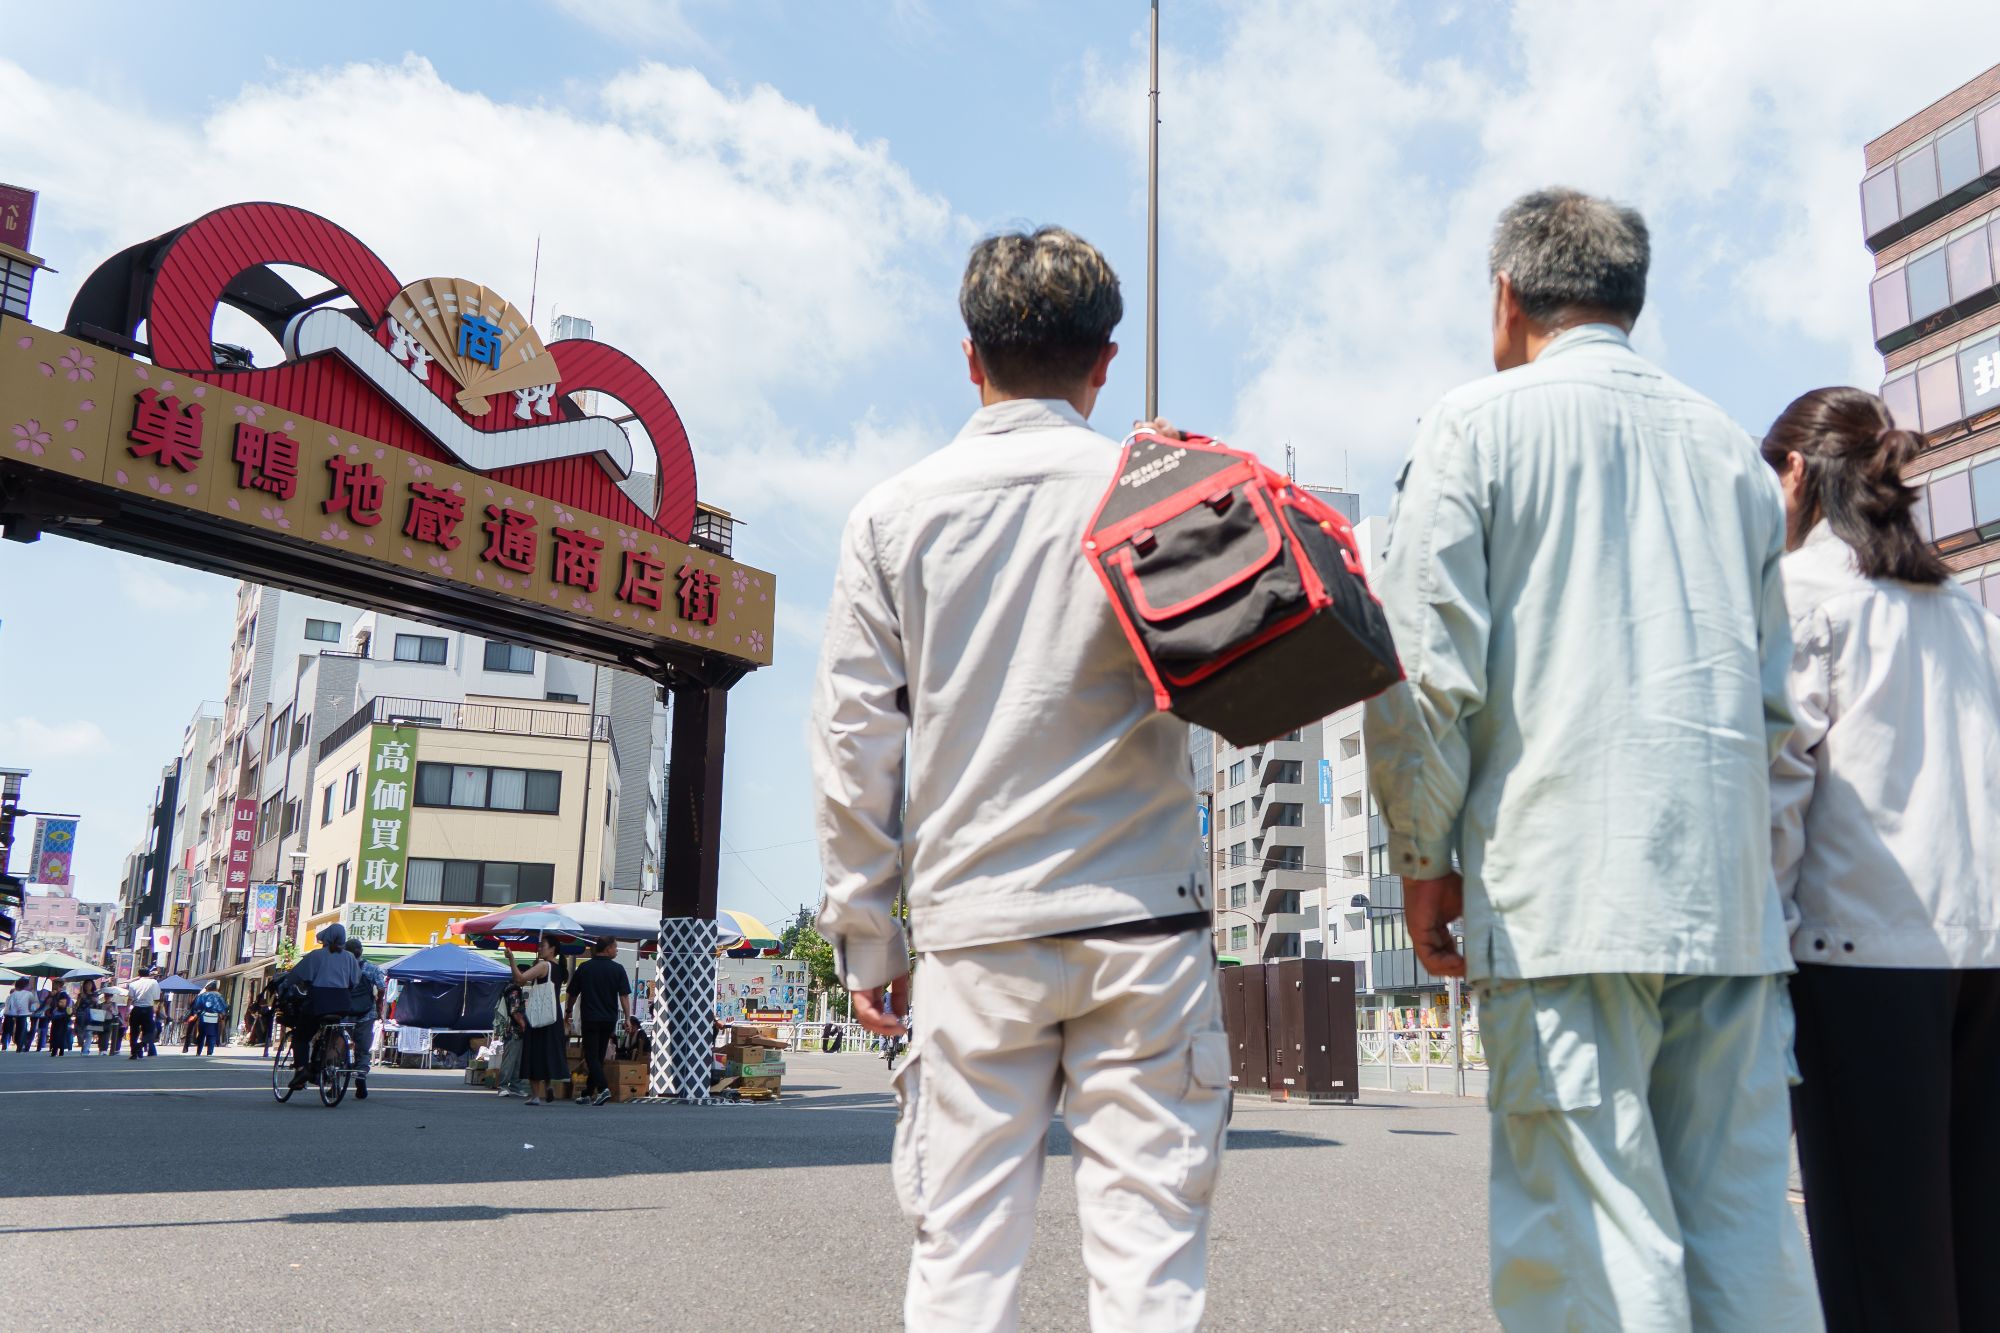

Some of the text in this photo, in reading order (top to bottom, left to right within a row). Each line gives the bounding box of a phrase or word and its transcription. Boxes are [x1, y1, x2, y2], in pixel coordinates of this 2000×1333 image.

[457, 313, 503, 370] 商
[1119, 448, 1187, 486] DENSAN
[126, 387, 721, 626] 巣鴨地蔵通商店街
[364, 741, 411, 890] 高価買取
[230, 809, 253, 883] 山和証券
[348, 923, 384, 941] 無料
[351, 904, 386, 923] 査定
